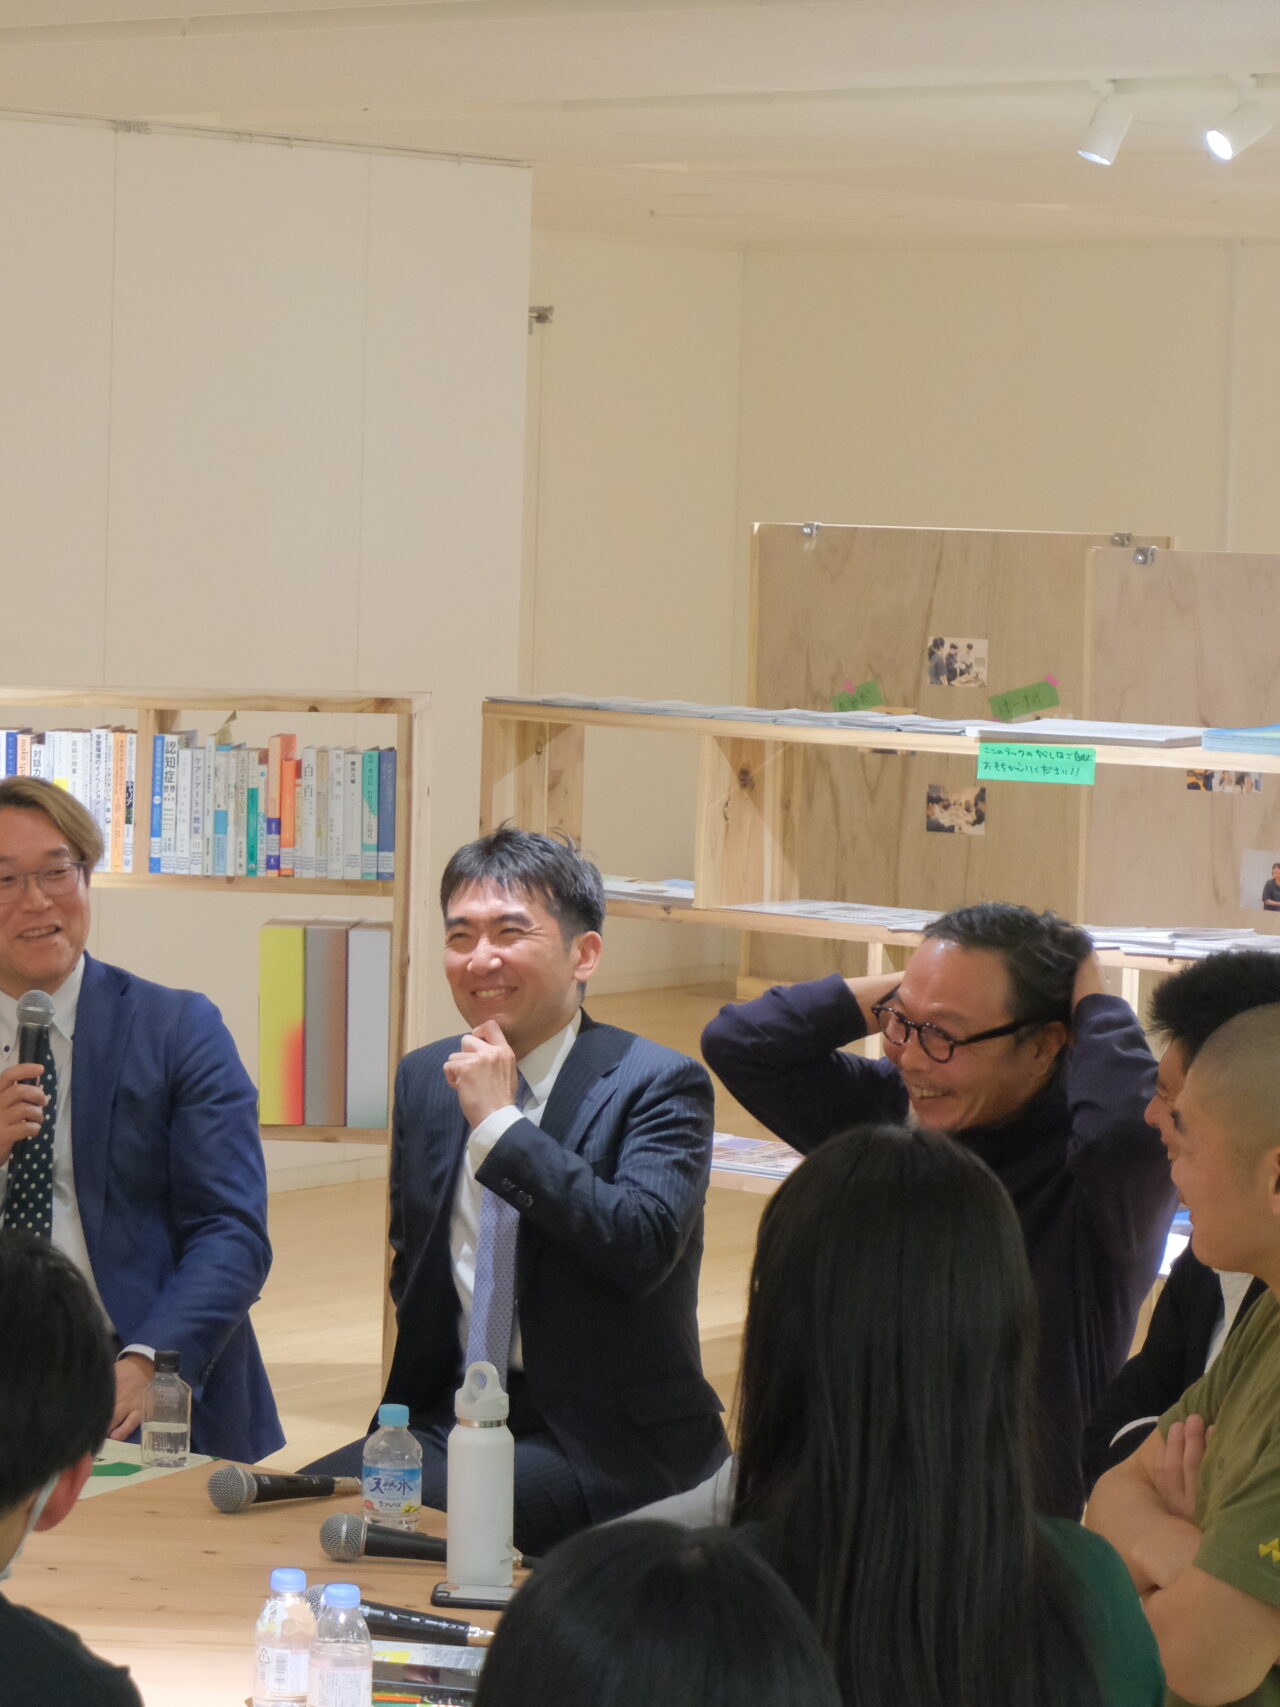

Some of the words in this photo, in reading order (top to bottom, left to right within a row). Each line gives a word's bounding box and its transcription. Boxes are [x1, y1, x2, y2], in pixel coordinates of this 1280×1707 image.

[164, 740, 177, 783] 認知症
[369, 1476, 414, 1496] 天然水
